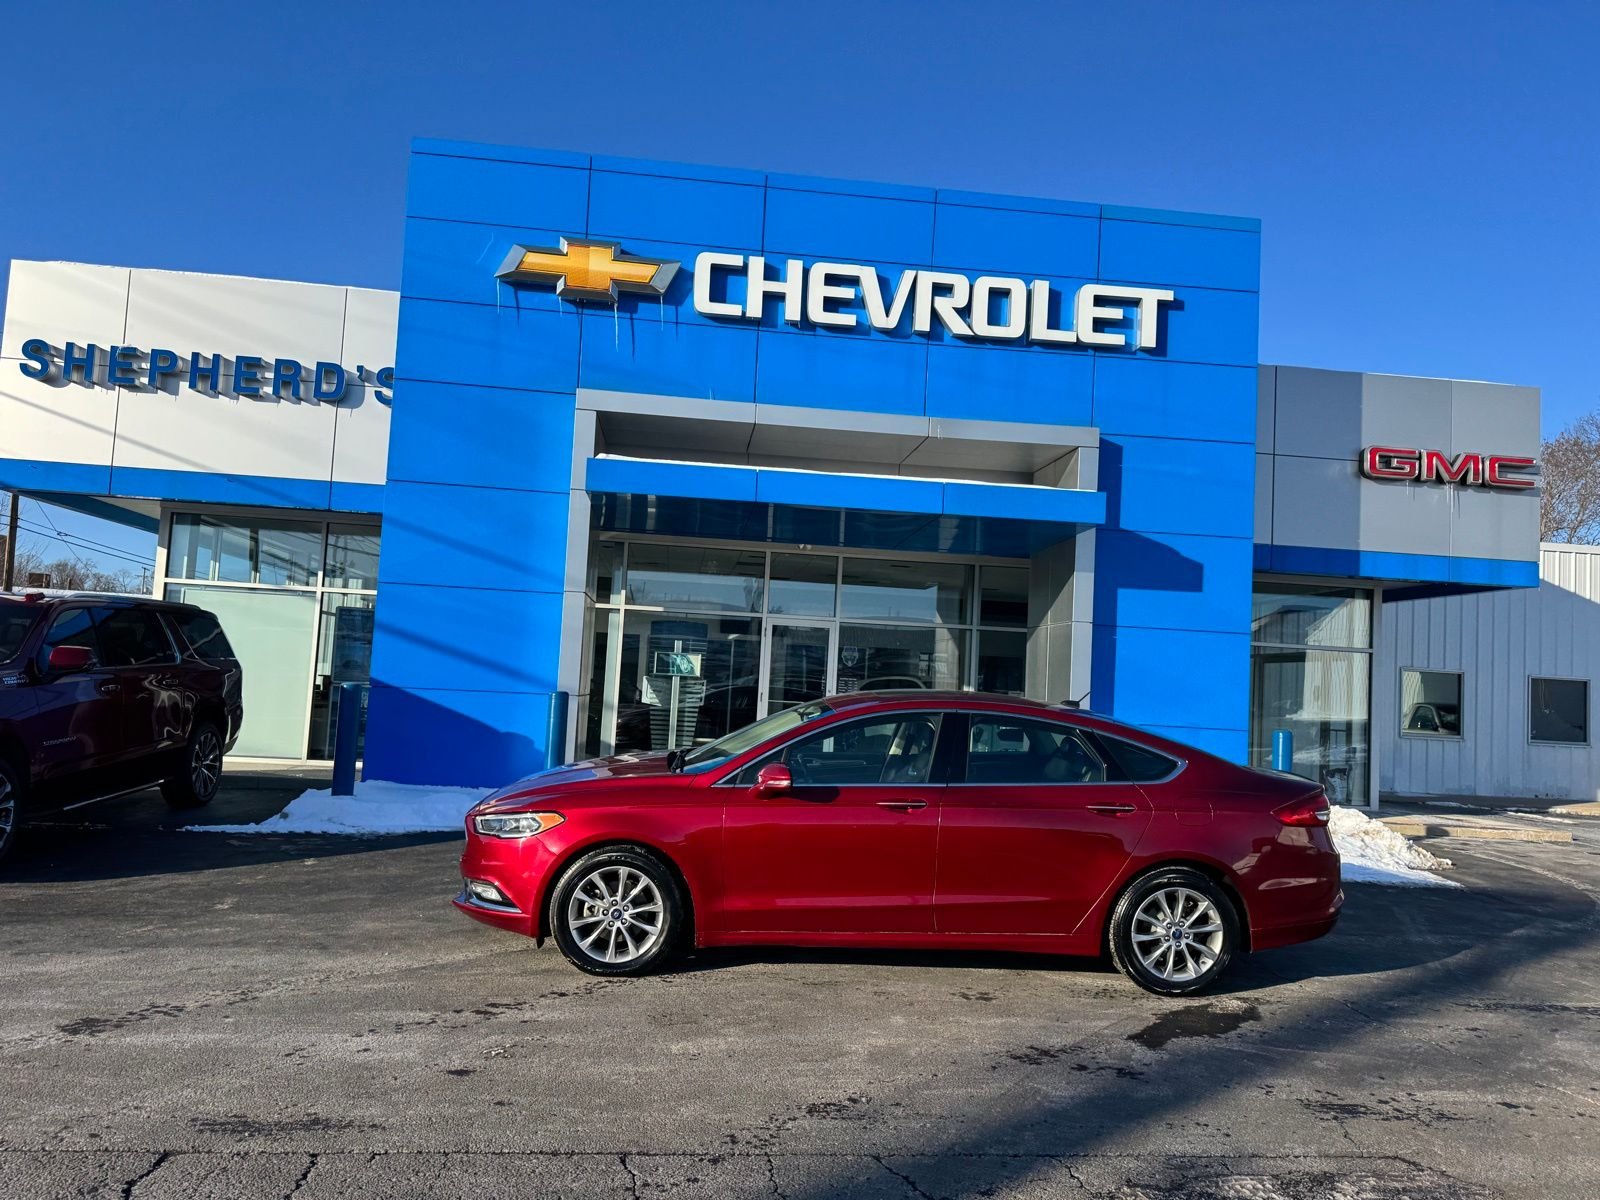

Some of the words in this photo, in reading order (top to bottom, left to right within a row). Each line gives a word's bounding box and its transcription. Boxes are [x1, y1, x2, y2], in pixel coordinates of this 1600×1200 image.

[693, 251, 1175, 350] CHEVROLET
[19, 338, 394, 408] SHEPHERD'S
[1363, 445, 1537, 487] GMC
